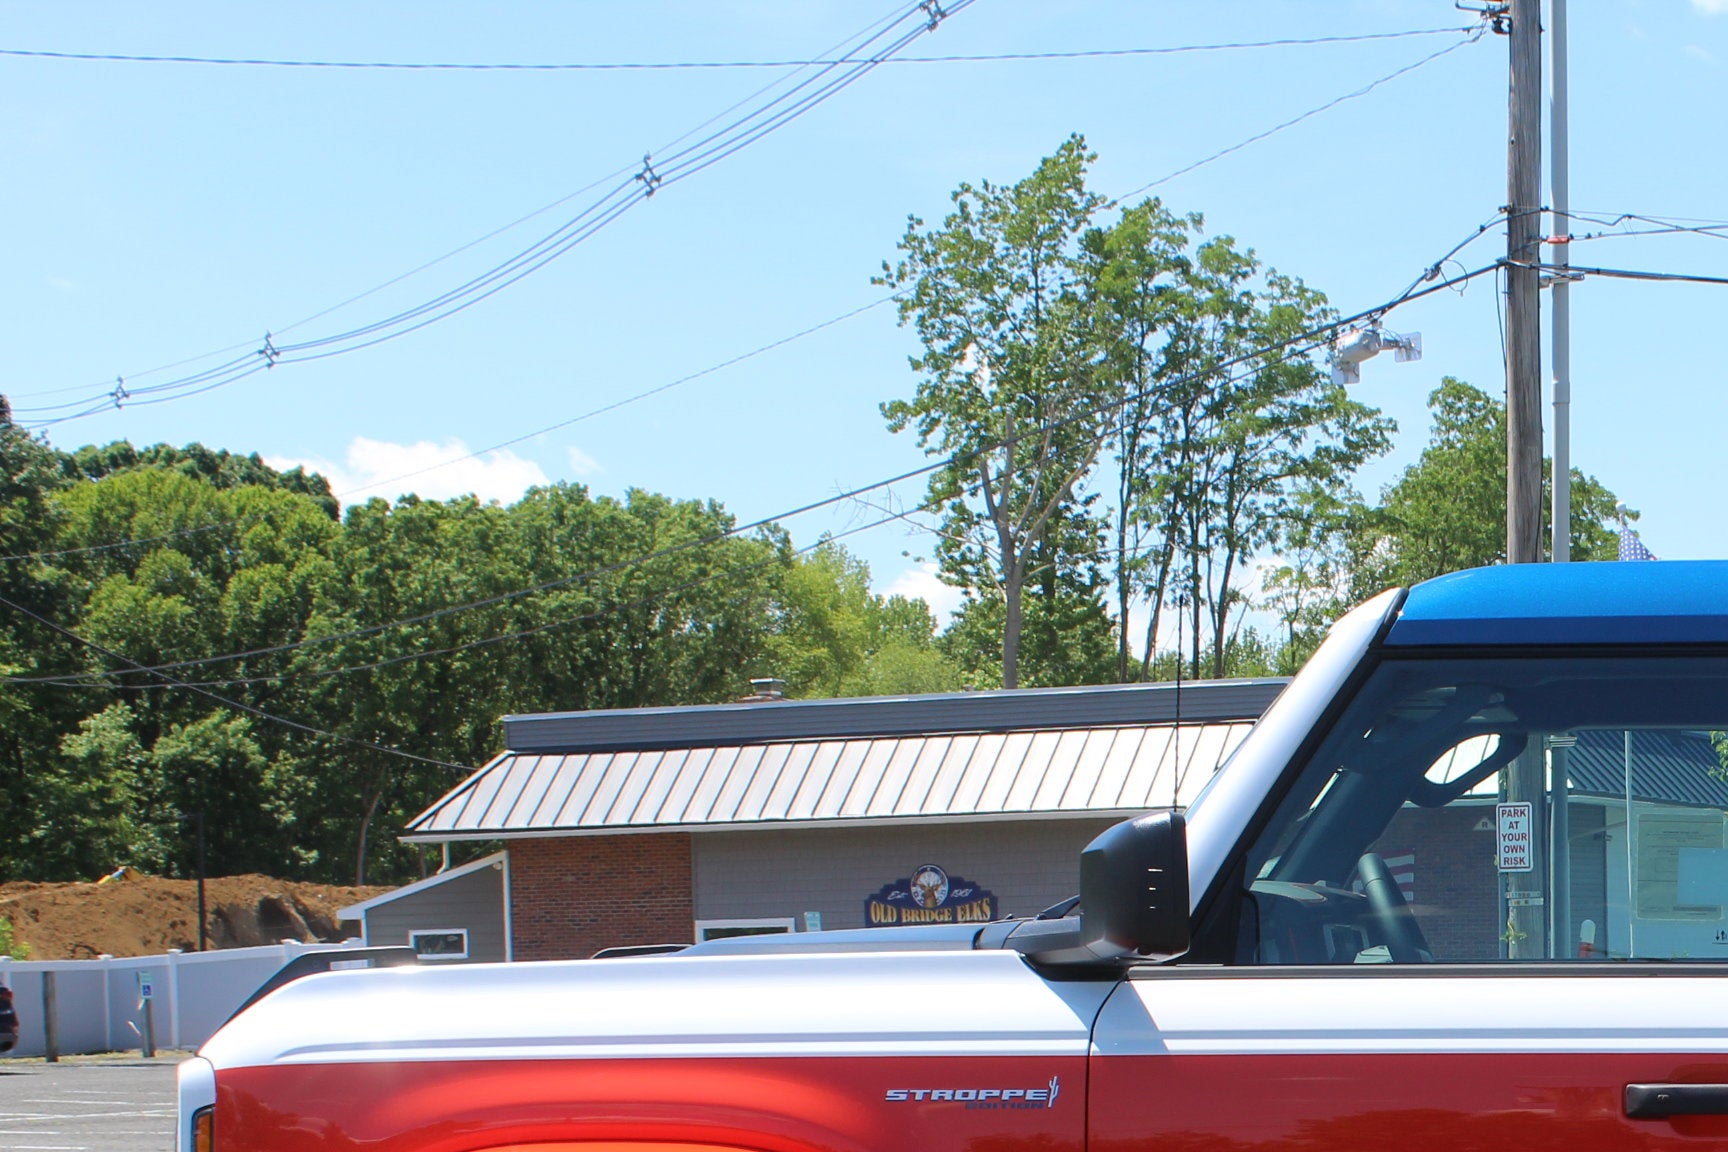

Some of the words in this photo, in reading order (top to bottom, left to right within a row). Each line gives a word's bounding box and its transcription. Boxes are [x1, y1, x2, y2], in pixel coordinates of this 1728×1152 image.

[1501, 808, 1526, 818] PARK
[1508, 821, 1520, 830] AT
[1501, 833, 1528, 842] YOUR
[1503, 845, 1525, 854] OWN
[1503, 857, 1526, 866] RISK
[870, 901, 897, 923] OLD
[902, 908, 952, 923] BRIDGE
[957, 898, 991, 921] ELKS
[885, 1089, 1049, 1101] STROPPE
